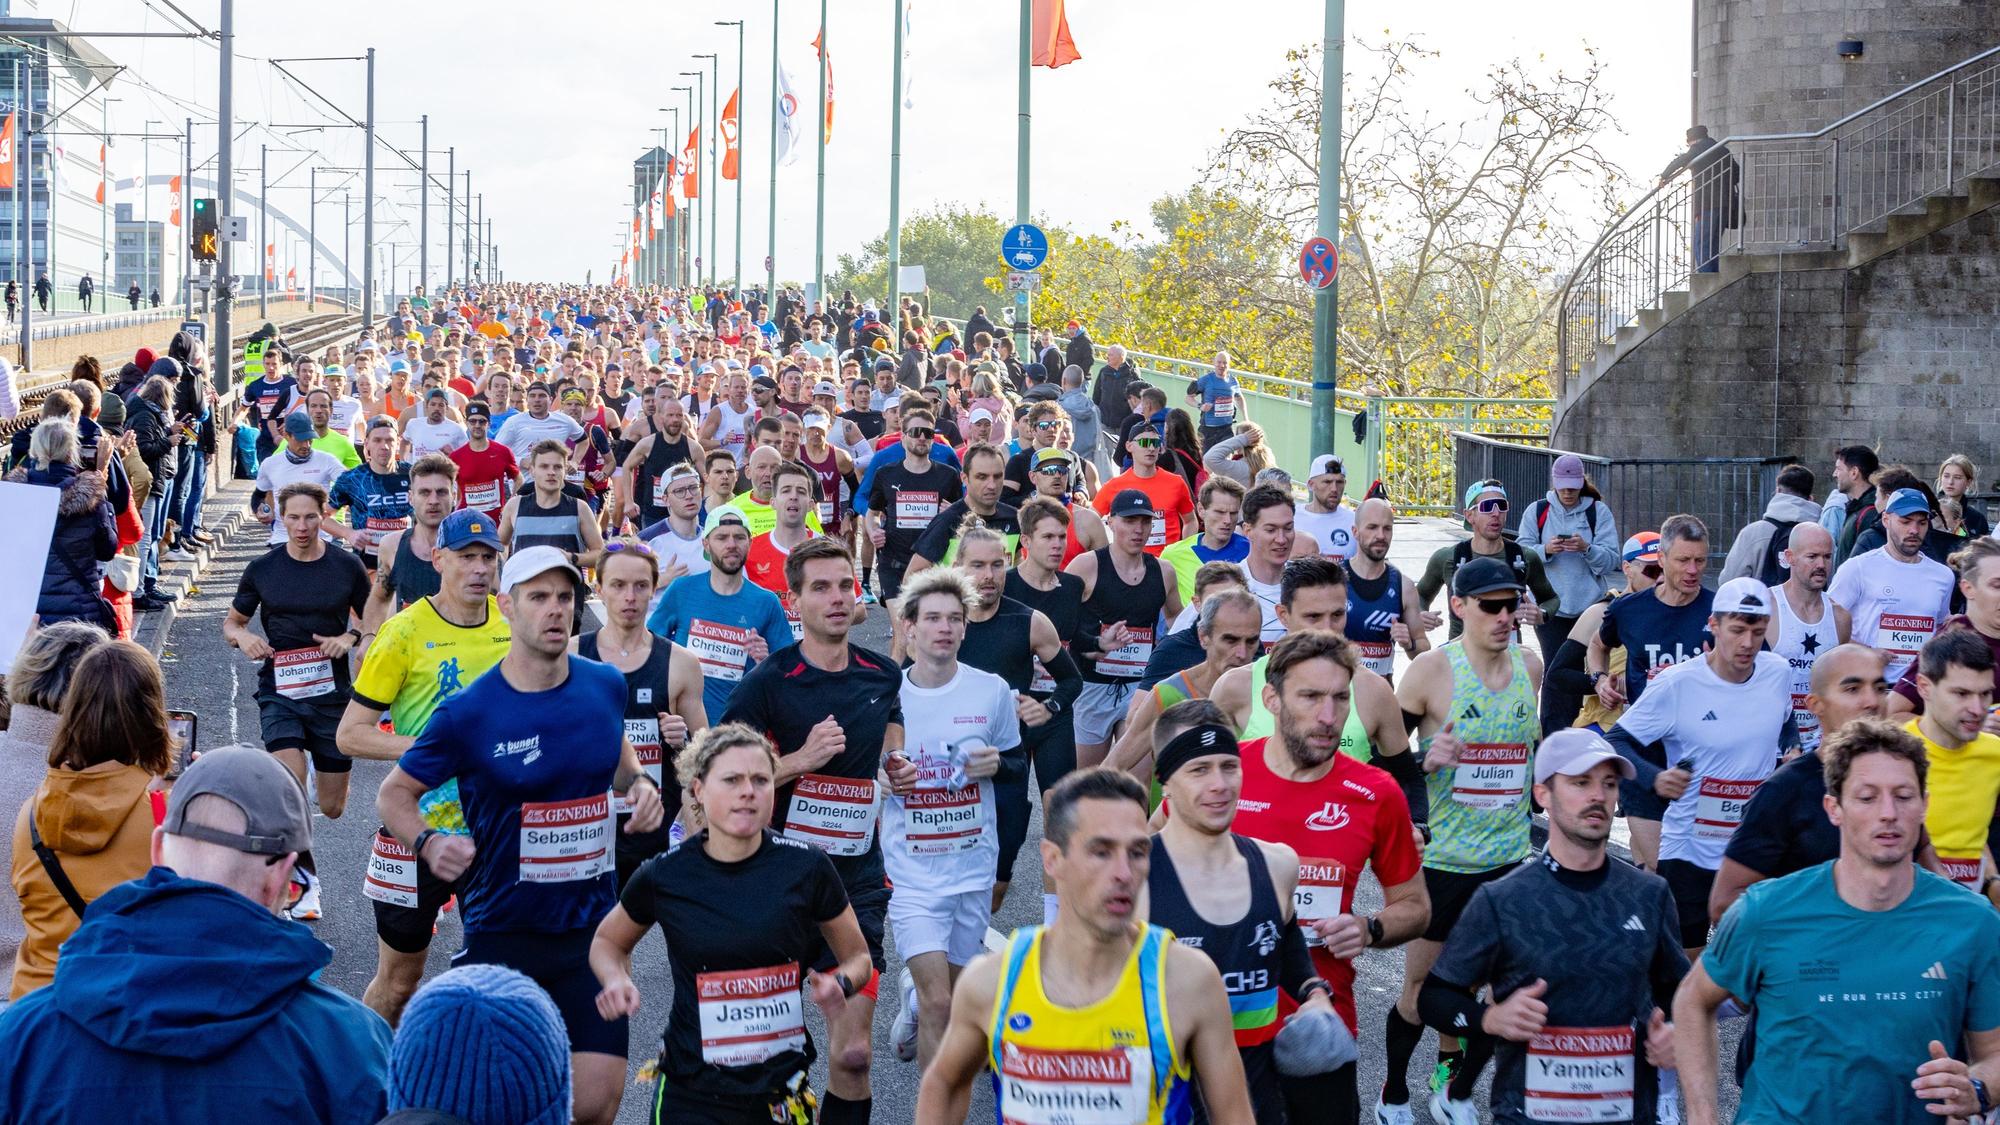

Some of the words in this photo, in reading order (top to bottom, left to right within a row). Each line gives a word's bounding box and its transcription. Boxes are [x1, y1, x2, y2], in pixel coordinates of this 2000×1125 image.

[204, 234, 217, 254] K
[905, 504, 930, 512] David
[704, 625, 745, 643] GENERAL
[1894, 618, 1934, 630] GENERALI
[691, 637, 744, 657] Christian
[1892, 631, 1923, 644] Kevin
[278, 663, 329, 678] Johannes
[1477, 748, 1527, 760] GENERALI
[1471, 766, 1514, 780] Julian
[818, 782, 873, 799] GENERALI
[546, 801, 608, 823] GENERALI
[796, 799, 867, 820] Domenico
[912, 806, 976, 827] Raphael
[527, 824, 604, 845] Sebastian
[725, 970, 797, 996] GENERALI
[1818, 994, 1835, 1003] WE
[1843, 993, 1867, 1002] RUN
[1875, 991, 1907, 1001] THIS
[716, 998, 790, 1023] Jasmin
[1553, 1034, 1632, 1052] GENERALI
[1027, 1053, 1129, 1081] GENERALI
[1538, 1057, 1625, 1079] Yannick
[1009, 1080, 1123, 1111] Dominiek
